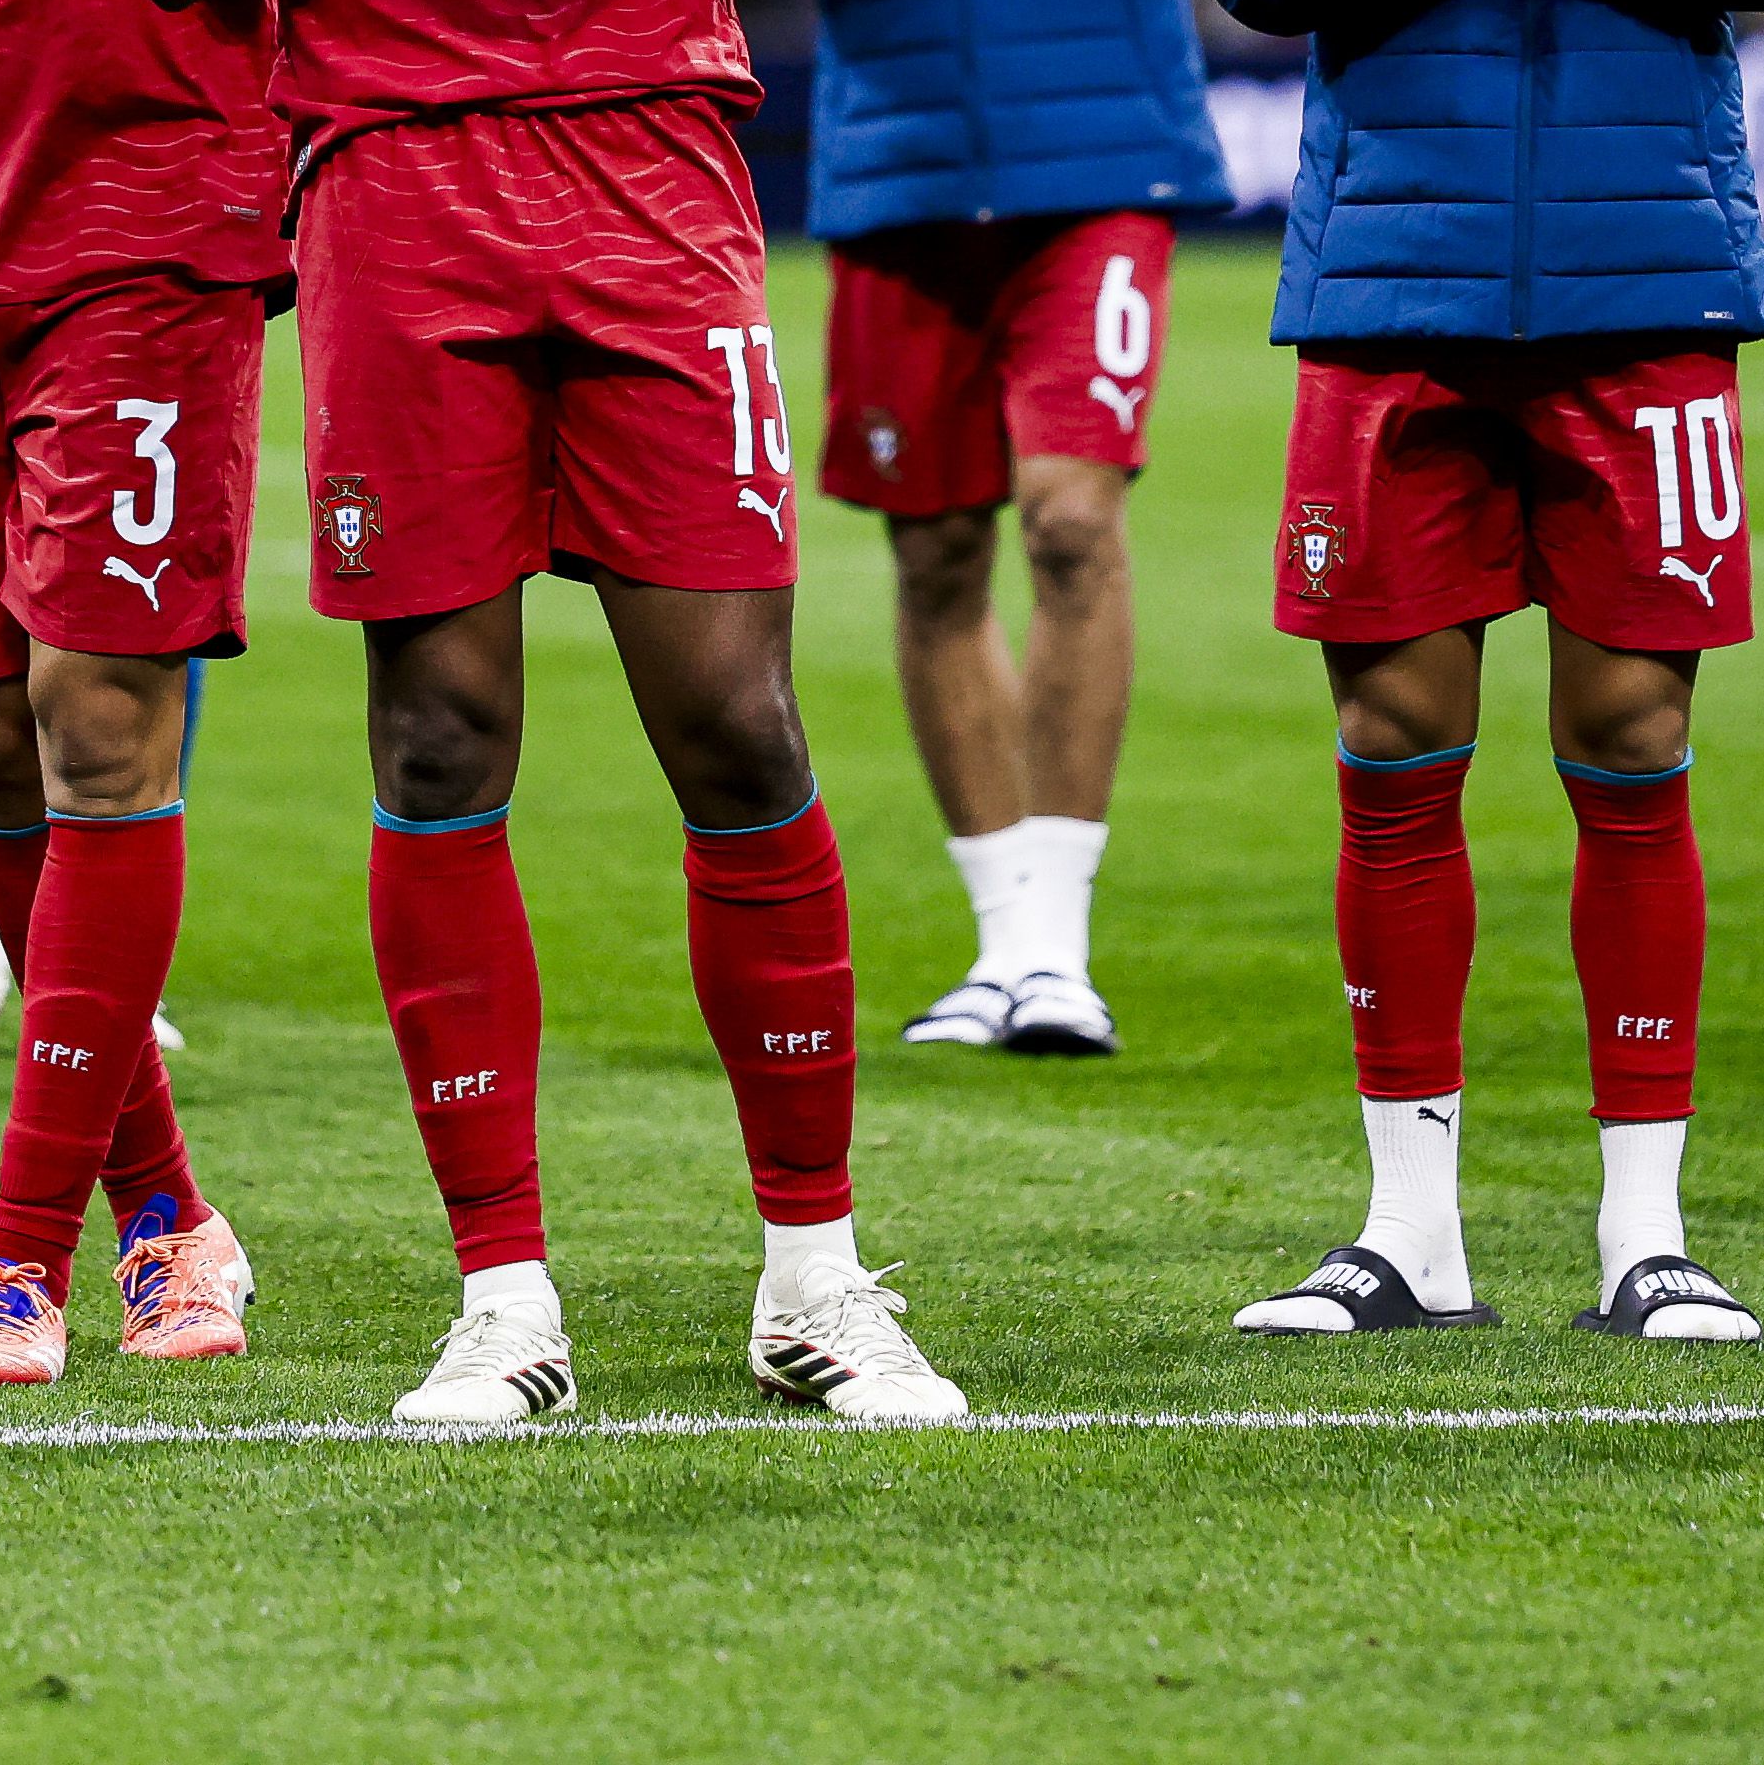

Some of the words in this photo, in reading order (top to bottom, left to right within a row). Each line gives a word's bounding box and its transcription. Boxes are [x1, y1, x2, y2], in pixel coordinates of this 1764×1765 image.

[1094, 255, 1151, 378] 6
[706, 324, 792, 476] 13
[111, 398, 179, 546] 3
[1634, 392, 1742, 548] 10
[32, 1040, 94, 1072] F.P.F.
[763, 1029, 832, 1054] F.P.F.
[1617, 1014, 1674, 1040] F.P.F.
[432, 1069, 499, 1104] F.P.F.
